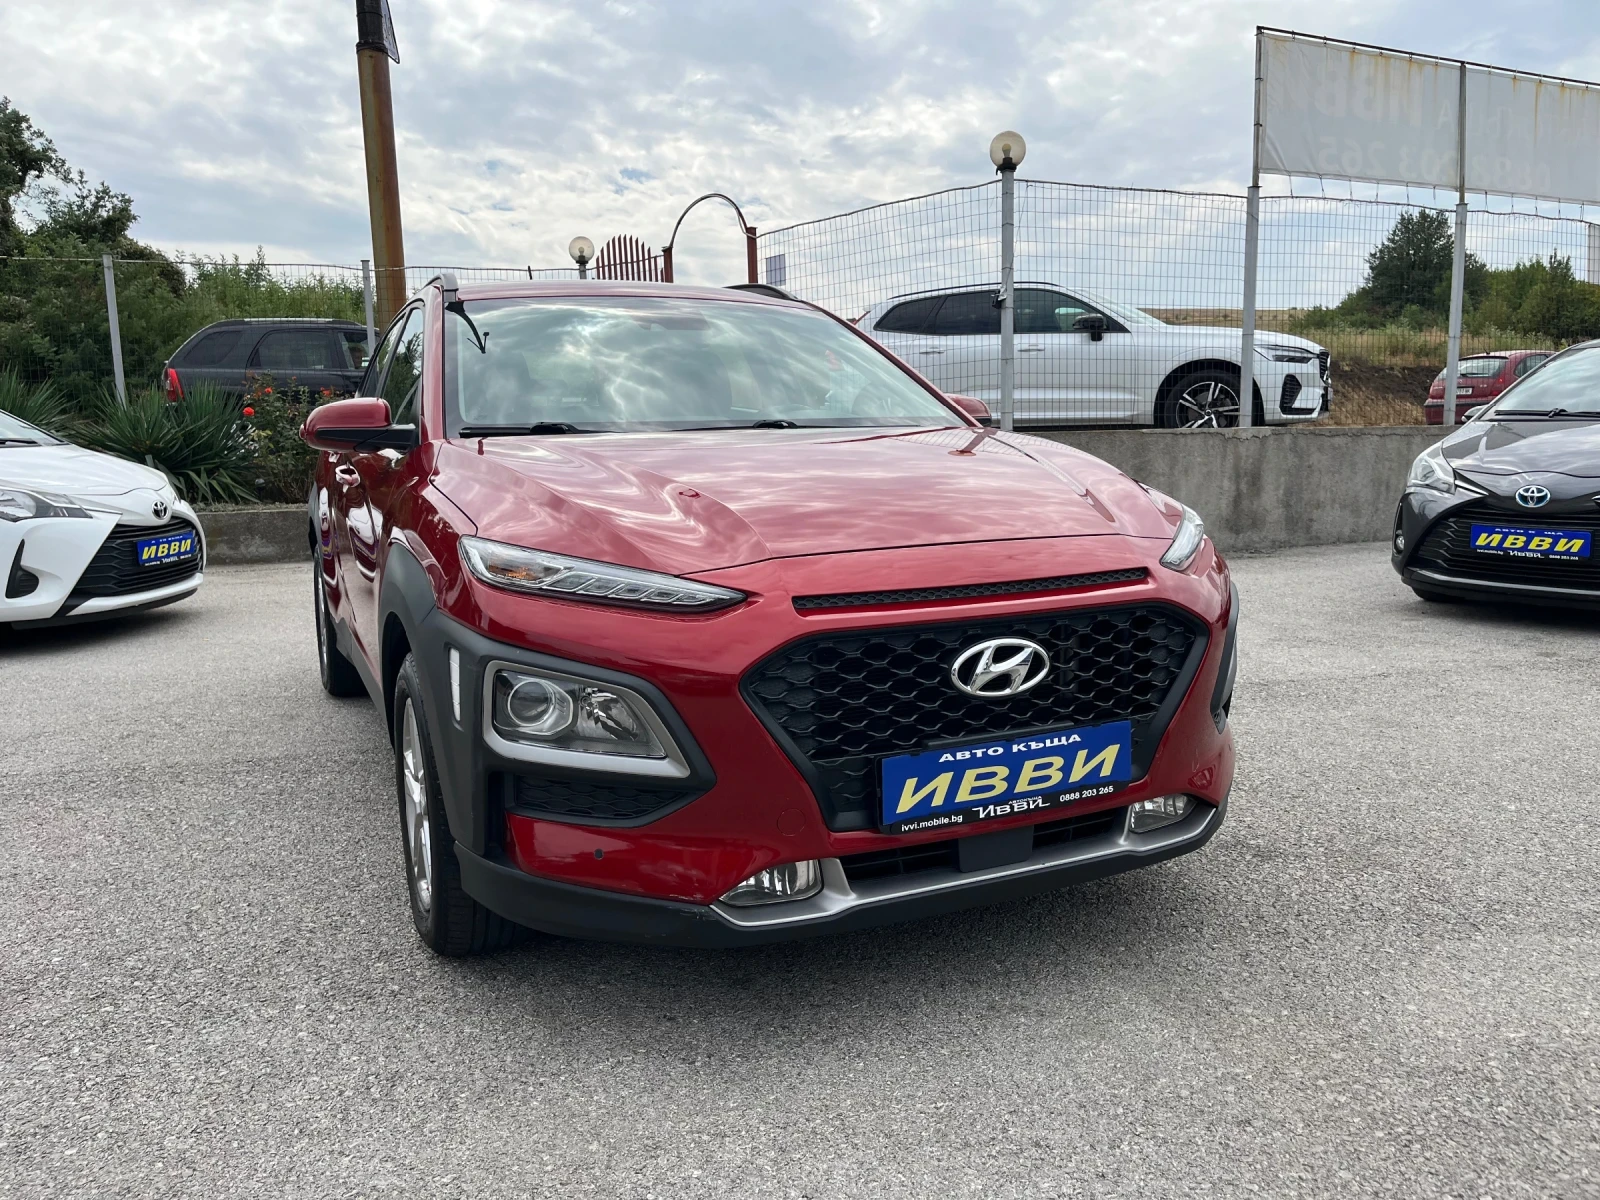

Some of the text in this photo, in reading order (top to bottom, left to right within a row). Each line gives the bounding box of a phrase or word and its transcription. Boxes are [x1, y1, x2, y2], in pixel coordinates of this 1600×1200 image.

[142, 539, 192, 560] ИВВИ
[1475, 533, 1585, 553] ИВВИ
[938, 733, 1082, 763] АВТО КЪЩА
[895, 744, 1121, 814] ИВВИ
[1059, 784, 1114, 802] 0888 203 265
[901, 813, 963, 832] ivvi.mobile.bg
